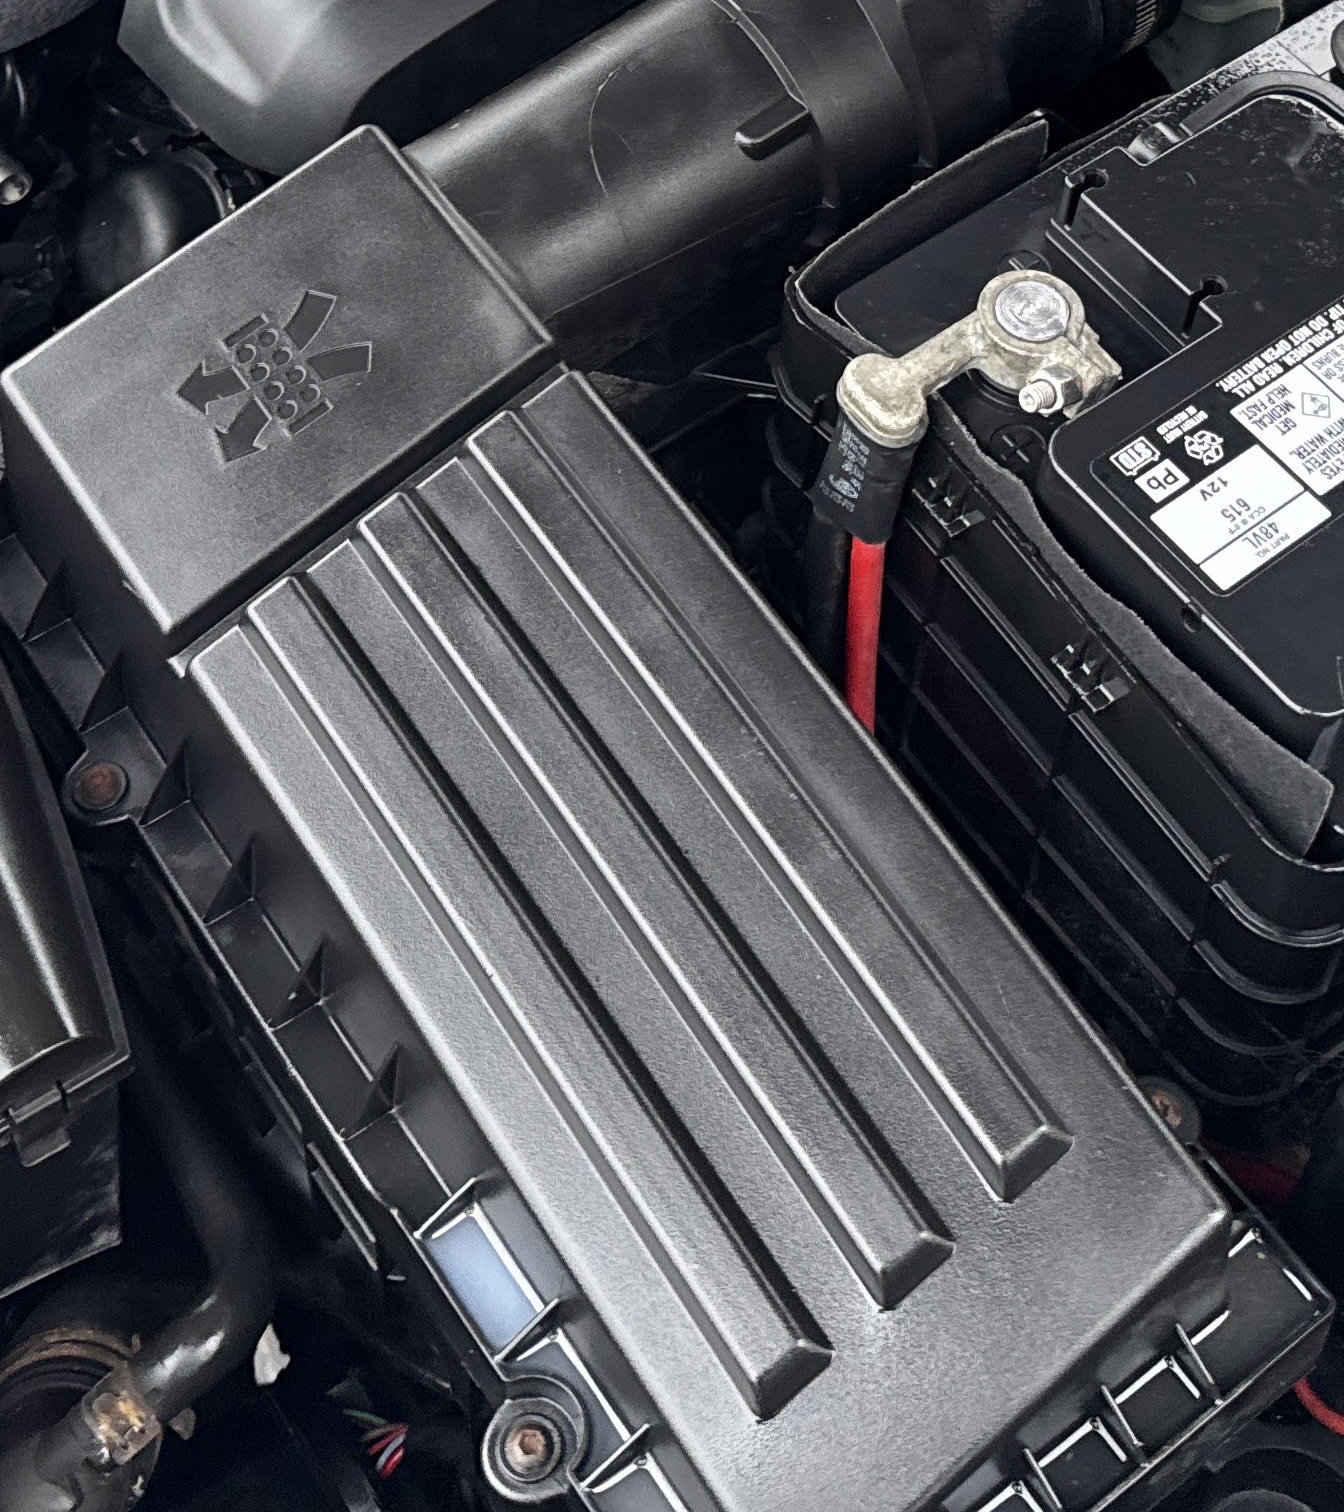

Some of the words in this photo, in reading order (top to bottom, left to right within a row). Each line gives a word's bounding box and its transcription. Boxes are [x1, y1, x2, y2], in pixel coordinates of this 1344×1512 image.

[1307, 314, 1329, 332] DO
[1281, 327, 1335, 367] CHILDREN.
[1287, 324, 1314, 347] NOT
[1259, 338, 1292, 364] OPEN
[1310, 347, 1342, 371] BURNS
[1218, 356, 1266, 393] BATTERY.
[1251, 361, 1284, 386] READ
[1320, 367, 1337, 381] OR
[1230, 378, 1256, 399] ALL
[1265, 383, 1292, 405] HELP
[1240, 398, 1269, 421] FAST.
[1250, 399, 1296, 431] MEDICAL
[1274, 416, 1297, 436] GET
[1288, 432, 1329, 460] WATER.
[1145, 466, 1180, 490] Pb
[1199, 476, 1229, 502] 12V
[1219, 497, 1251, 523] 615
[1241, 521, 1280, 549] 48VL
[1270, 532, 1291, 550] PART
